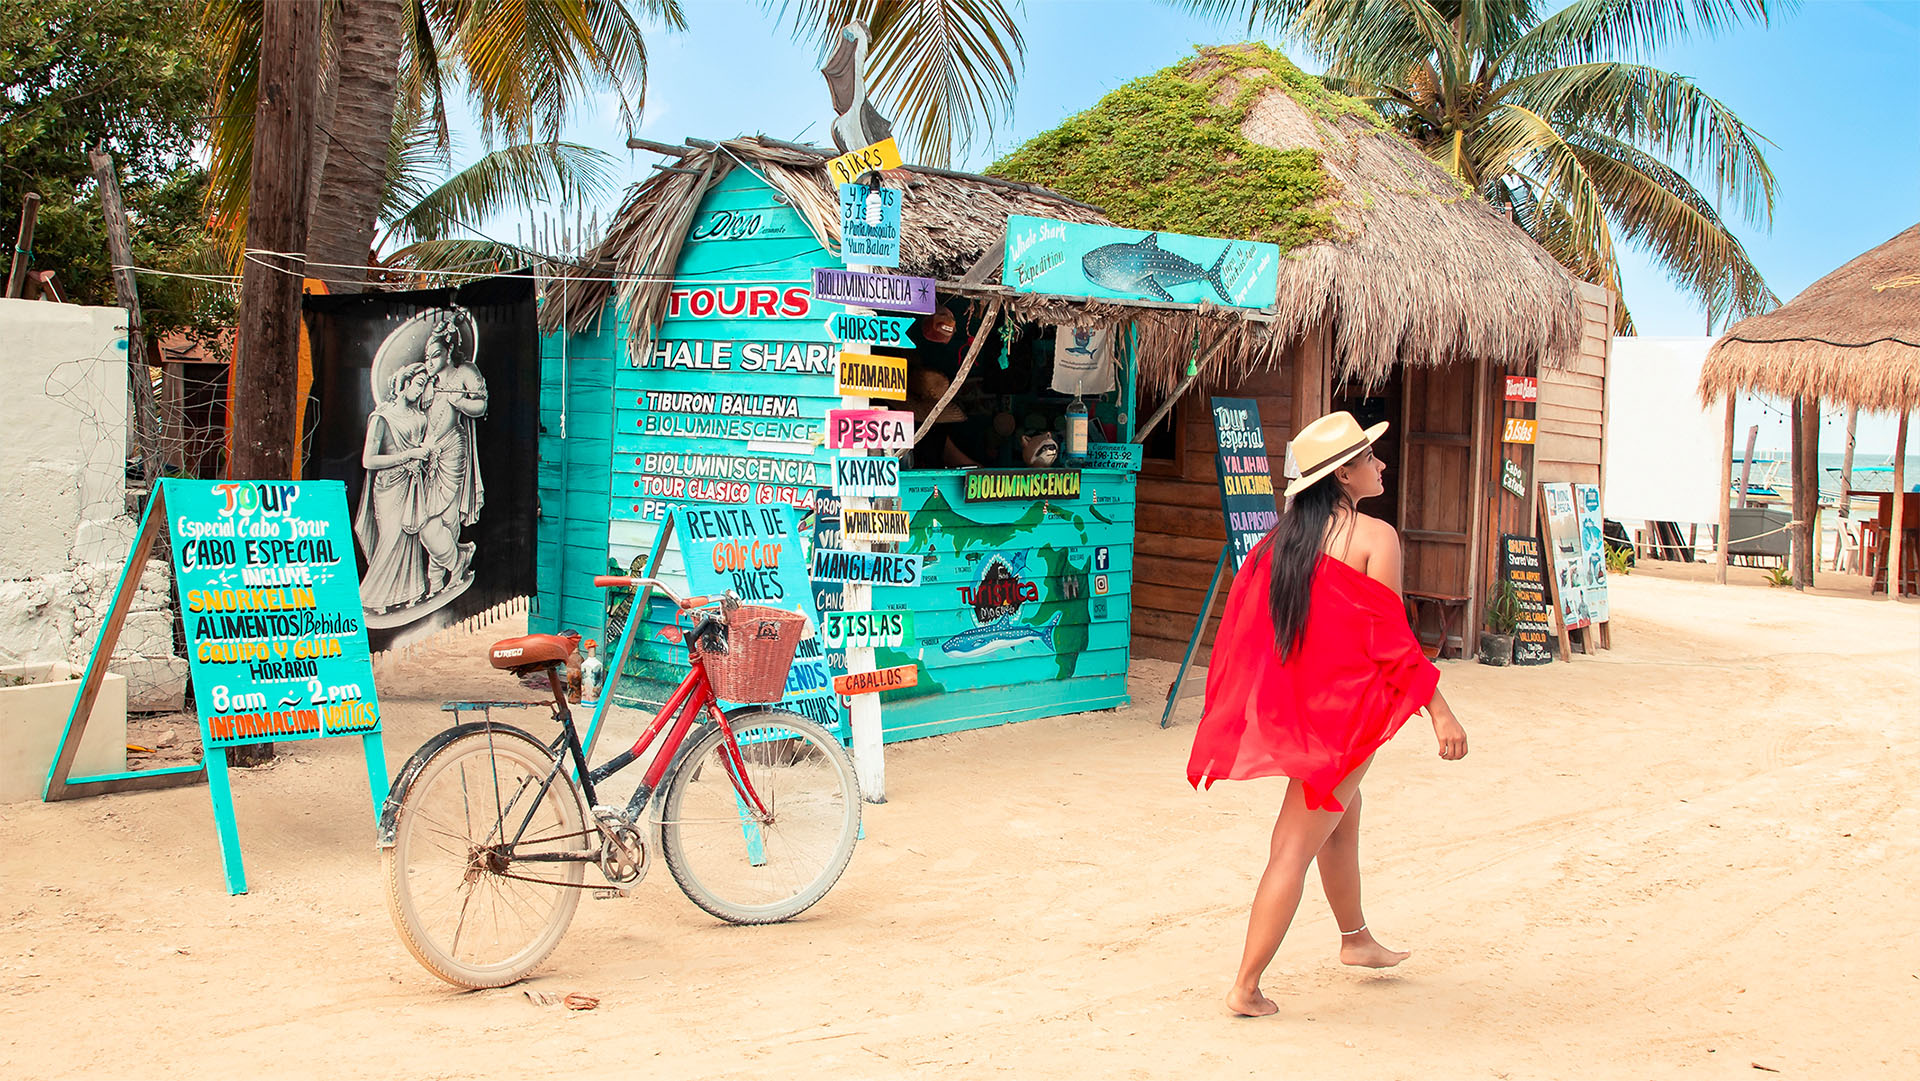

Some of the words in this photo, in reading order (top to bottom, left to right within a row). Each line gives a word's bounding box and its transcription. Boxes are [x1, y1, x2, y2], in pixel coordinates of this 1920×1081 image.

[850, 186, 857, 202] 4
[845, 203, 852, 218] 3
[818, 272, 912, 303] BIOLUMINISCENCIA
[669, 287, 811, 318] TOURS
[838, 316, 900, 343] HORSES
[840, 362, 906, 391] CATAMARAN
[646, 392, 715, 413] TIBURON
[720, 395, 799, 417] BALLENA
[838, 419, 905, 446] PESCA
[1220, 427, 1264, 453] especial
[1505, 420, 1513, 441] 3
[644, 453, 817, 485] BIOLUMINISCENCIA
[1086, 451, 1132, 461] 4-198-13-92
[1223, 456, 1269, 473] YALAHAU
[838, 460, 896, 487] KAYAKS
[1505, 460, 1522, 480] Cabo
[641, 475, 685, 498] TOUR
[687, 480, 751, 503] CLASICO
[967, 472, 1080, 499] BIOLUMINISCENCIA
[177, 516, 235, 537] Especial
[237, 517, 280, 538] Cabo
[686, 508, 757, 542] RENTA
[760, 508, 787, 540] DE
[182, 539, 237, 571] CABO
[245, 539, 341, 568] ESPECIAL
[815, 551, 916, 584] MANGLARES
[241, 567, 313, 589] INCLUYE
[732, 570, 785, 602] BIKES
[188, 588, 317, 614] SNORKELIN
[829, 616, 842, 640] 3
[847, 615, 902, 639] ISLAS
[198, 641, 269, 664] EQUIPO
[273, 641, 288, 662] Y
[293, 638, 342, 660] GUIA
[250, 660, 318, 683] HORARIO
[846, 668, 902, 691] CABALLOS
